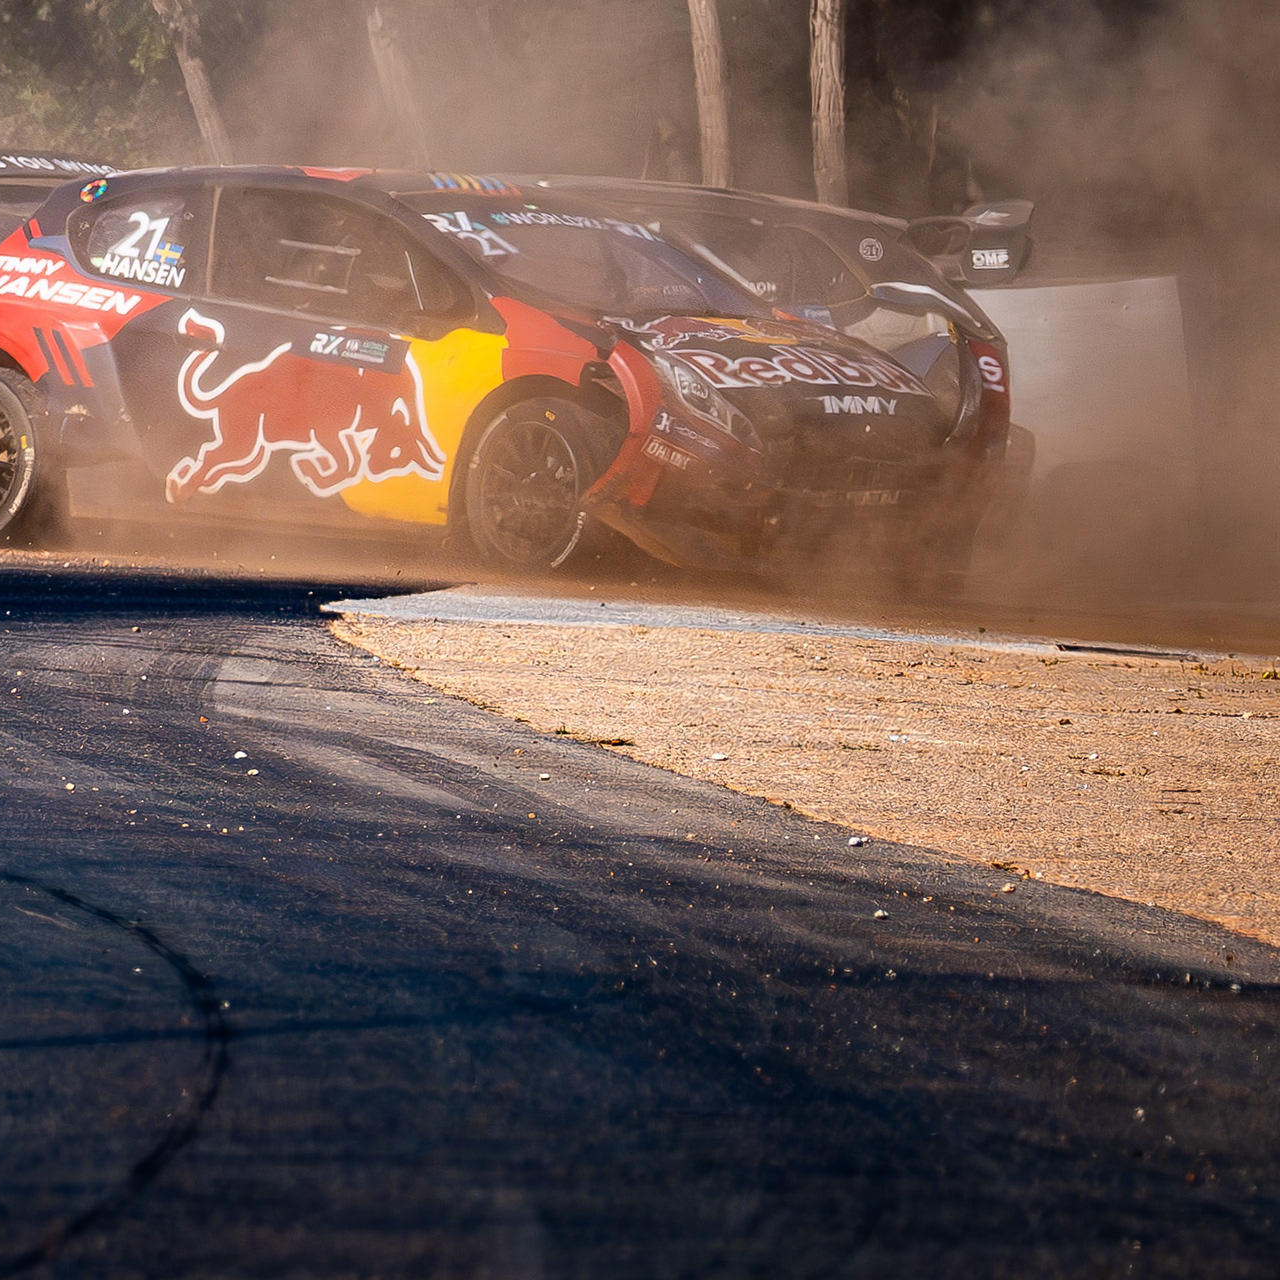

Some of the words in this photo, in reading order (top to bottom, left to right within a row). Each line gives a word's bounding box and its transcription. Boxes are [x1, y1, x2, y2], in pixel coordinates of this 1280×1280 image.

[1, 155, 56, 171] YOU
[114, 210, 171, 260] 21
[99, 252, 186, 289] HANSEN
